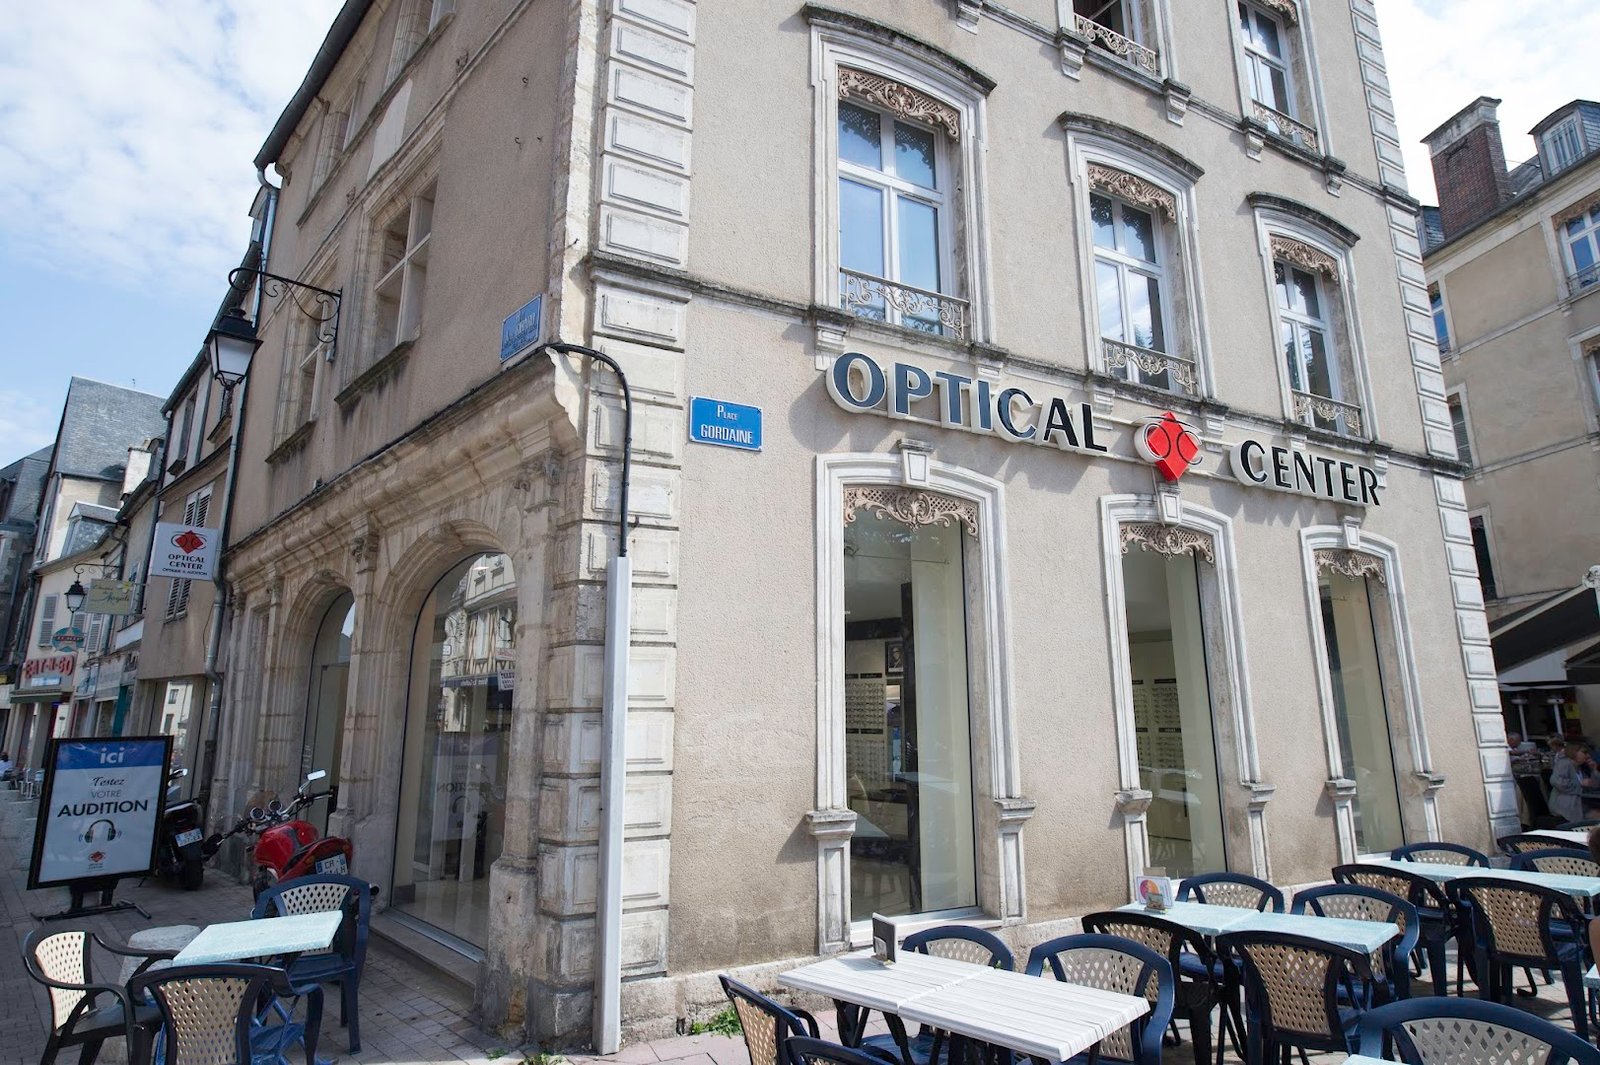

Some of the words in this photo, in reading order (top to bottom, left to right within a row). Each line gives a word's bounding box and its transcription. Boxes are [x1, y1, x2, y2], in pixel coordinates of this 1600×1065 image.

[828, 351, 1108, 453] OPTICAL
[700, 423, 753, 445] GORDAINE
[1235, 438, 1381, 507] CENTER
[168, 553, 205, 564] OPTICAL
[169, 560, 203, 570] CENTER
[100, 747, 125, 764] ici
[92, 776, 125, 787] Testez
[91, 790, 121, 799] VOTRE
[57, 800, 148, 817] AUDITION
